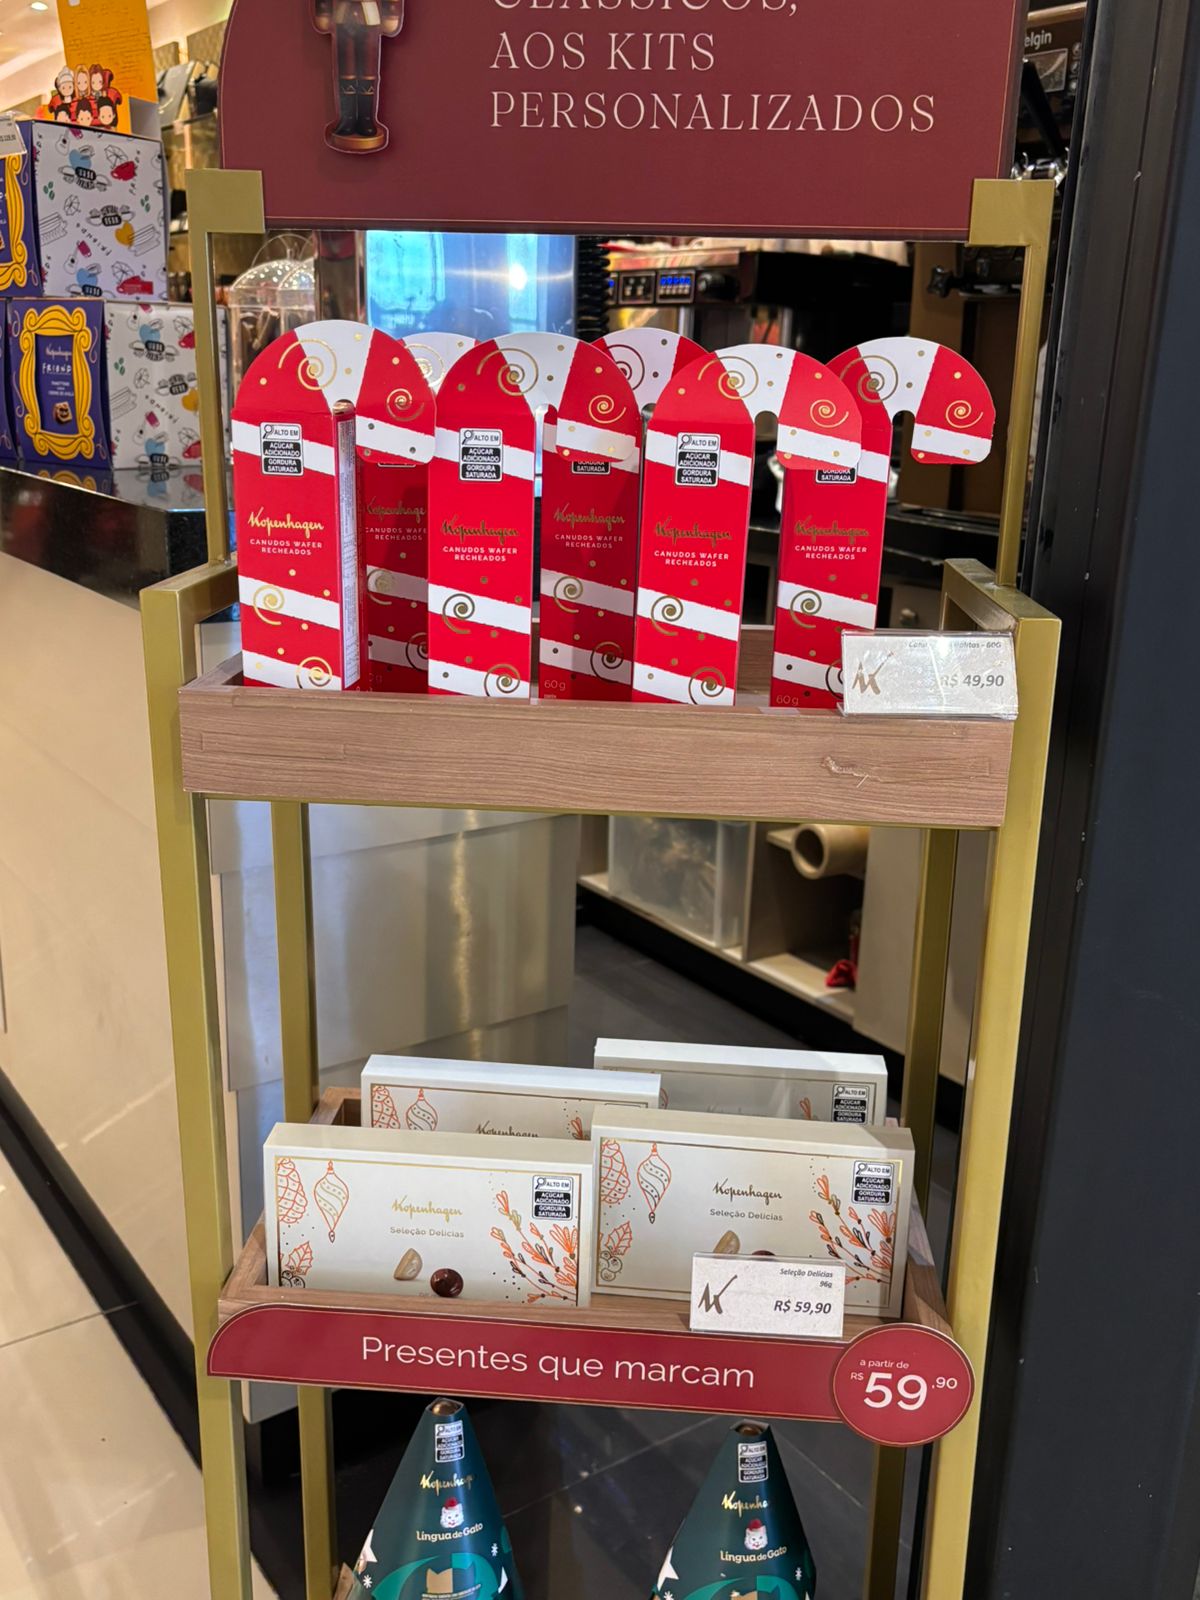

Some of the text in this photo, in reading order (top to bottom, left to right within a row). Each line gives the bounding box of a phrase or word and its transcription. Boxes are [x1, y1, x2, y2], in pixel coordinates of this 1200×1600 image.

[489, 31, 715, 71] AOS KITS
[489, 91, 935, 132] PERSONALIZADOS
[274, 429, 289, 437] ALTO
[474, 434, 499, 442] ALTO EM
[263, 449, 300, 457] ADICIONADO
[267, 458, 297, 466] GORDURA
[463, 455, 500, 463] ADICIONADO
[679, 459, 716, 467] ADICIONADO
[267, 465, 298, 473] SATURADA
[466, 464, 496, 472] GORDURA
[576, 465, 606, 473] SATURADA
[466, 471, 498, 479] SATURADA
[682, 469, 712, 477] GORDURA
[681, 476, 712, 484] SATURADA
[821, 474, 851, 482] SATURADA
[366, 496, 426, 524] Kopenhage
[554, 502, 625, 531] Kopenhagen
[248, 506, 324, 538] Kopenhagen
[441, 515, 519, 545] Kopenhagen
[655, 516, 733, 547] Kopenhagen
[795, 515, 869, 544] Kopenhagen
[250, 538, 322, 549] CANUDOS WAFER
[261, 548, 311, 556] RECHEADOS
[443, 546, 518, 555] CANUDOS WAFER
[795, 545, 835, 553] CANUDOS
[454, 554, 506, 562] RECHEADOS
[654, 550, 729, 560] CANUDOS WAFER
[805, 552, 855, 560] RECHEADOS
[665, 559, 717, 567] RECHEADOS
[963, 674, 1004, 689] 49,90
[713, 1178, 783, 1206] Kopenhagen
[391, 1195, 464, 1224] Kopenhagen
[709, 1208, 783, 1221] Seleção Delícias
[389, 1226, 427, 1238] Seleção
[779, 1268, 833, 1278] Seleção Delícias
[819, 1281, 833, 1289] 96g
[774, 1299, 832, 1315] R$ 59,90
[362, 1336, 755, 1389] Presentes que marcam
[868, 1360, 894, 1368] partir
[896, 1361, 910, 1369] de
[850, 1372, 864, 1381] R$
[452, 1530, 463, 1539] de
[463, 1522, 484, 1537] Gato
[757, 1553, 767, 1561] de
[767, 1545, 787, 1559] Gato
